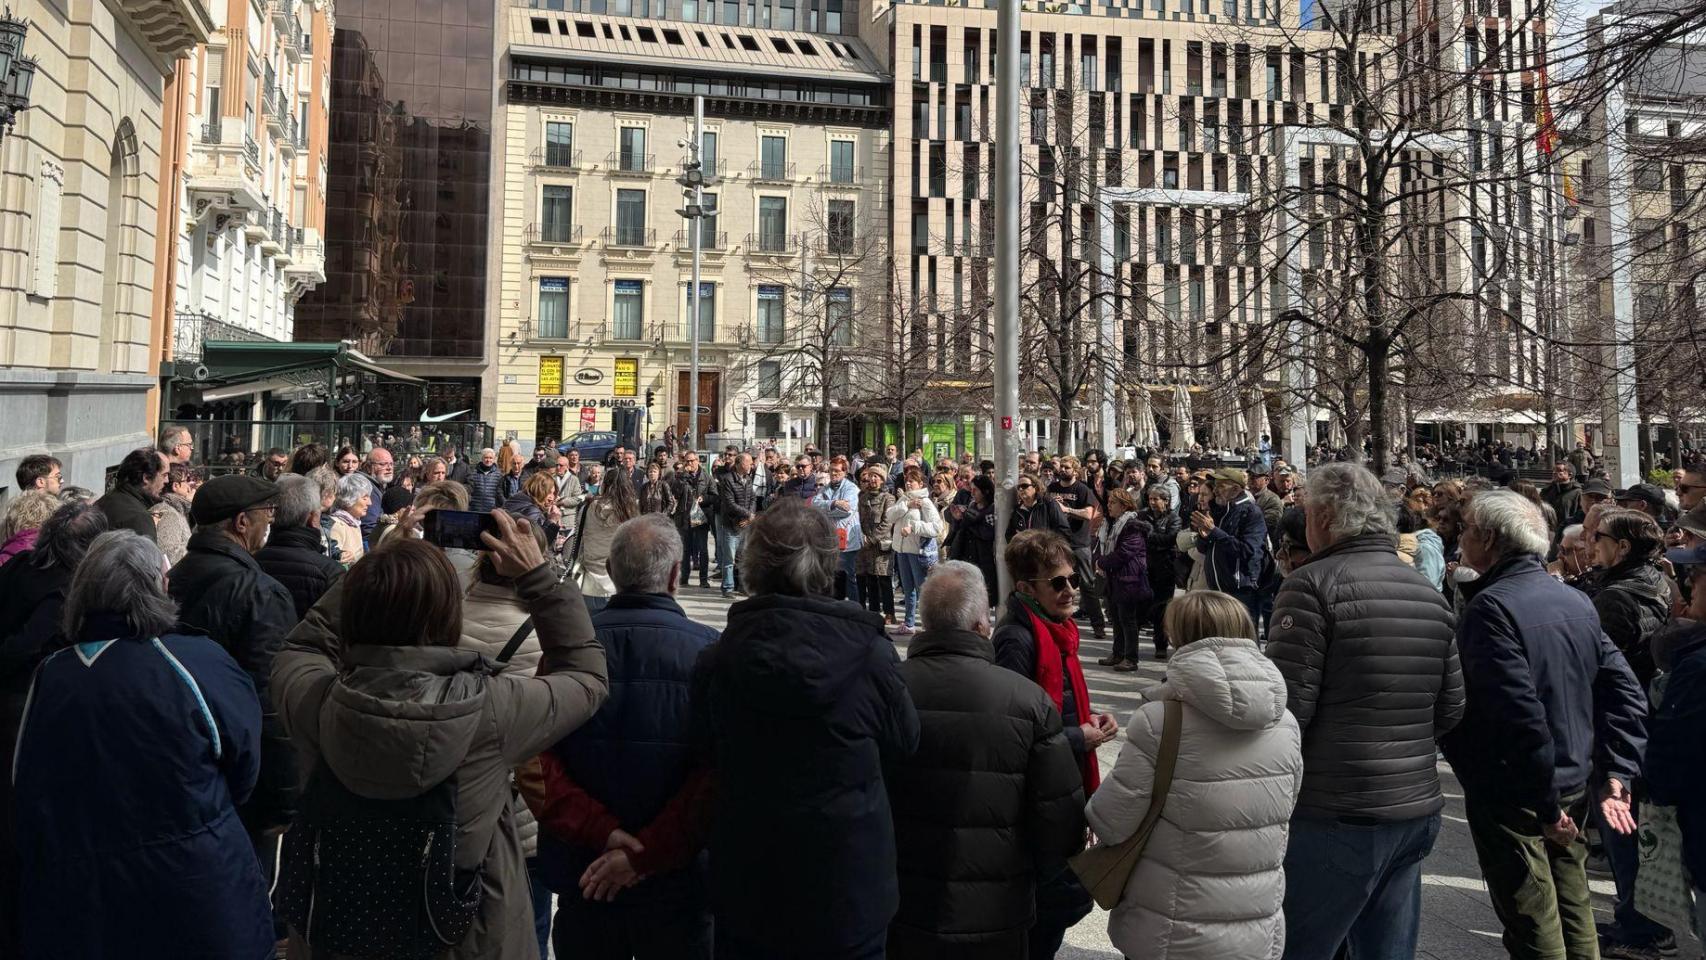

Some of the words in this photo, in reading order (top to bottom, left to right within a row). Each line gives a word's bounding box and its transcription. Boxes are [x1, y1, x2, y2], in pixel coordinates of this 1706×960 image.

[539, 398, 580, 408] ESCOGE
[583, 399, 597, 408] LO
[599, 399, 636, 408] BUENO
